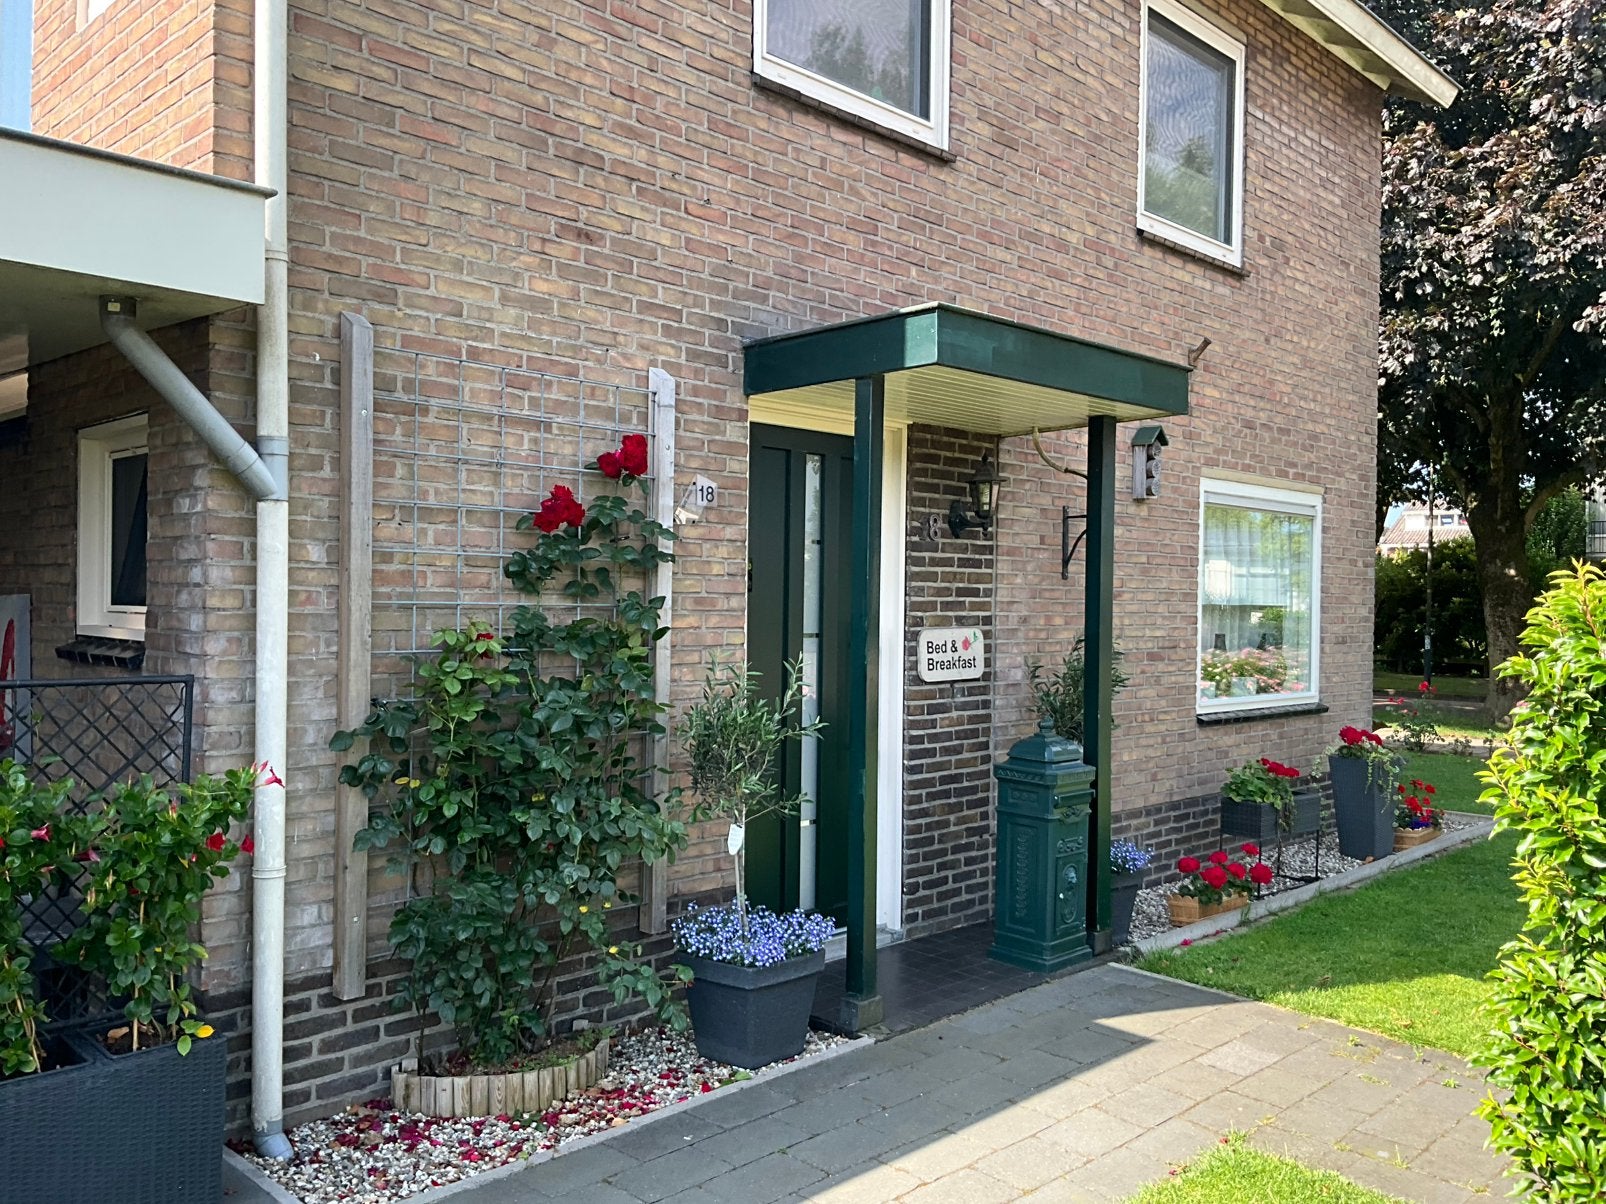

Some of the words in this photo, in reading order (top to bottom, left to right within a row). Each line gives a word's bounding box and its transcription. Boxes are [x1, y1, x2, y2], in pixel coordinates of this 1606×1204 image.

[698, 485, 715, 502] 18
[926, 639, 947, 654] Bed
[950, 639, 958, 653] &
[927, 655, 977, 671] Breakfast
